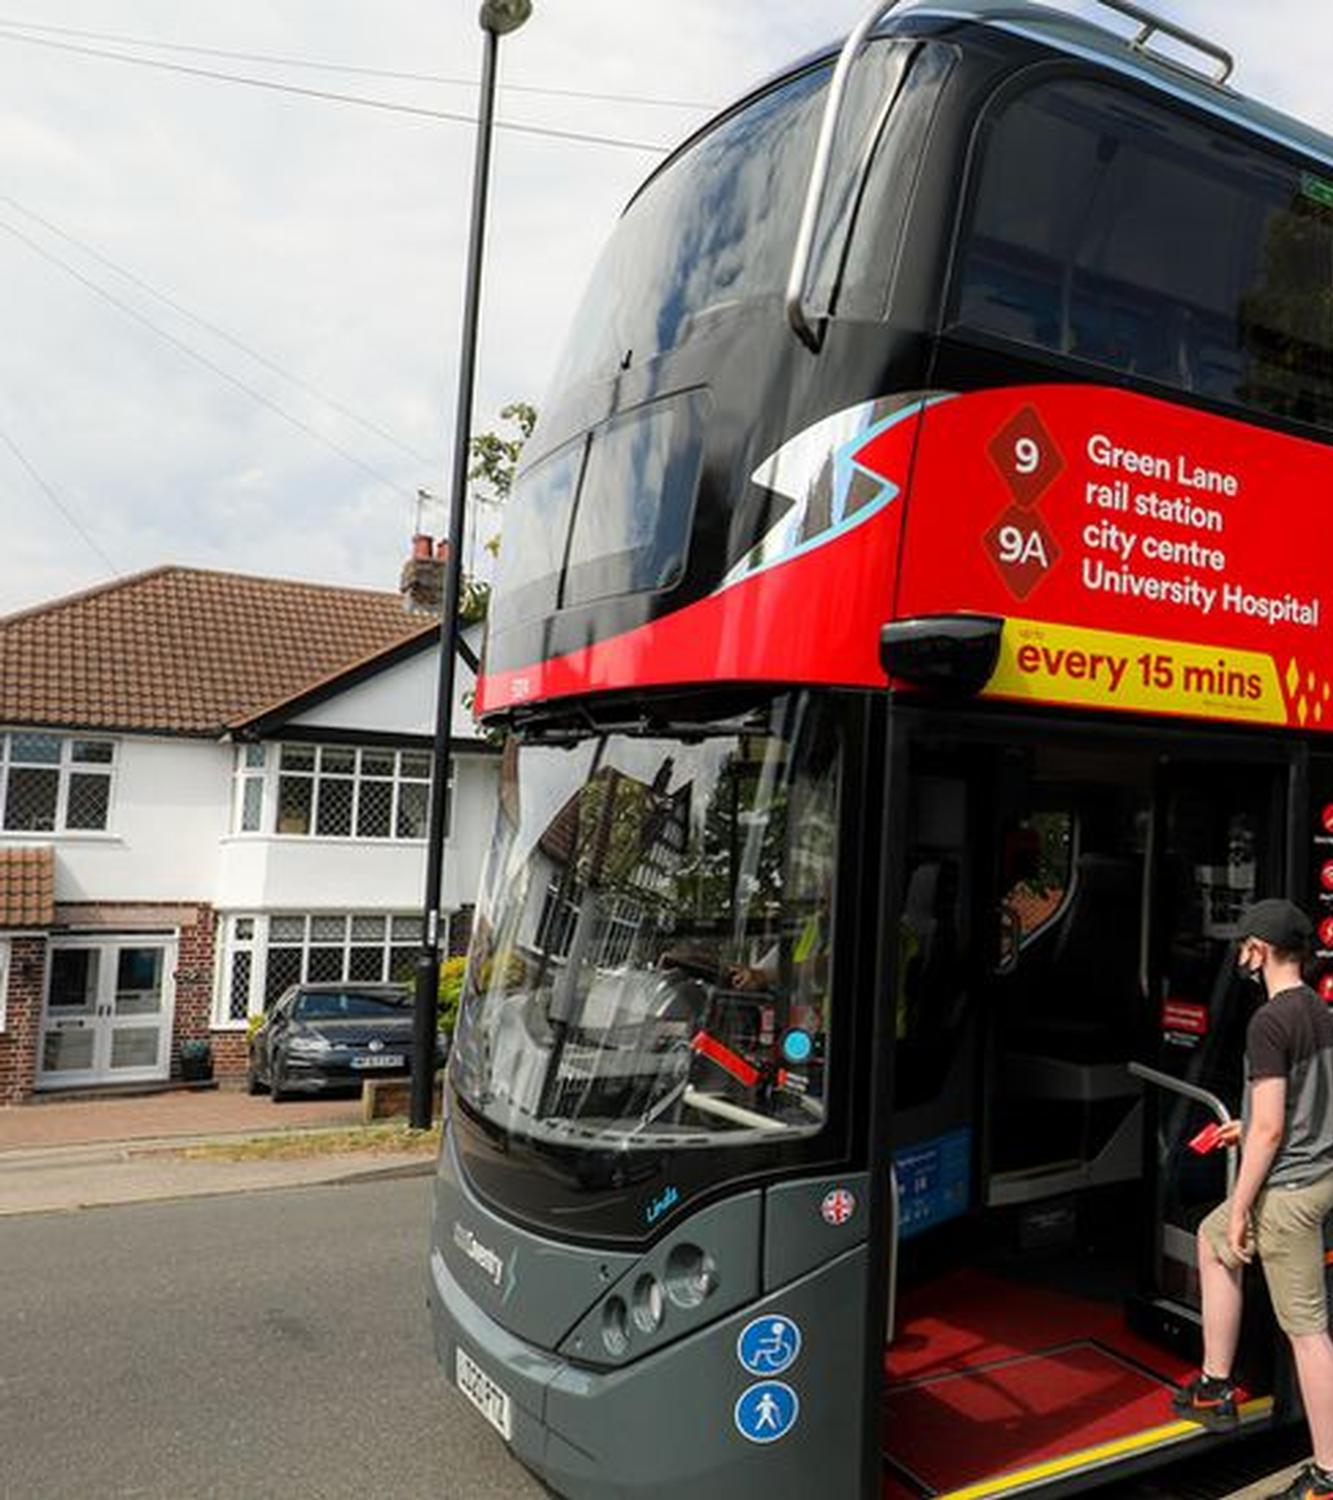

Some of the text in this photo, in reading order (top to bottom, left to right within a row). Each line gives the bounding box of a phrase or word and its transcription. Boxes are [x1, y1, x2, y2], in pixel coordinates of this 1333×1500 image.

[1014, 437, 1040, 474] 9
[1087, 434, 1239, 496] Green Lane
[1085, 480, 1223, 532] rail station
[998, 525, 1049, 569] 9A
[1082, 520, 1226, 571] city centre
[1082, 558, 1319, 627] University Hospital
[1016, 644, 1262, 700] every 15 mins
